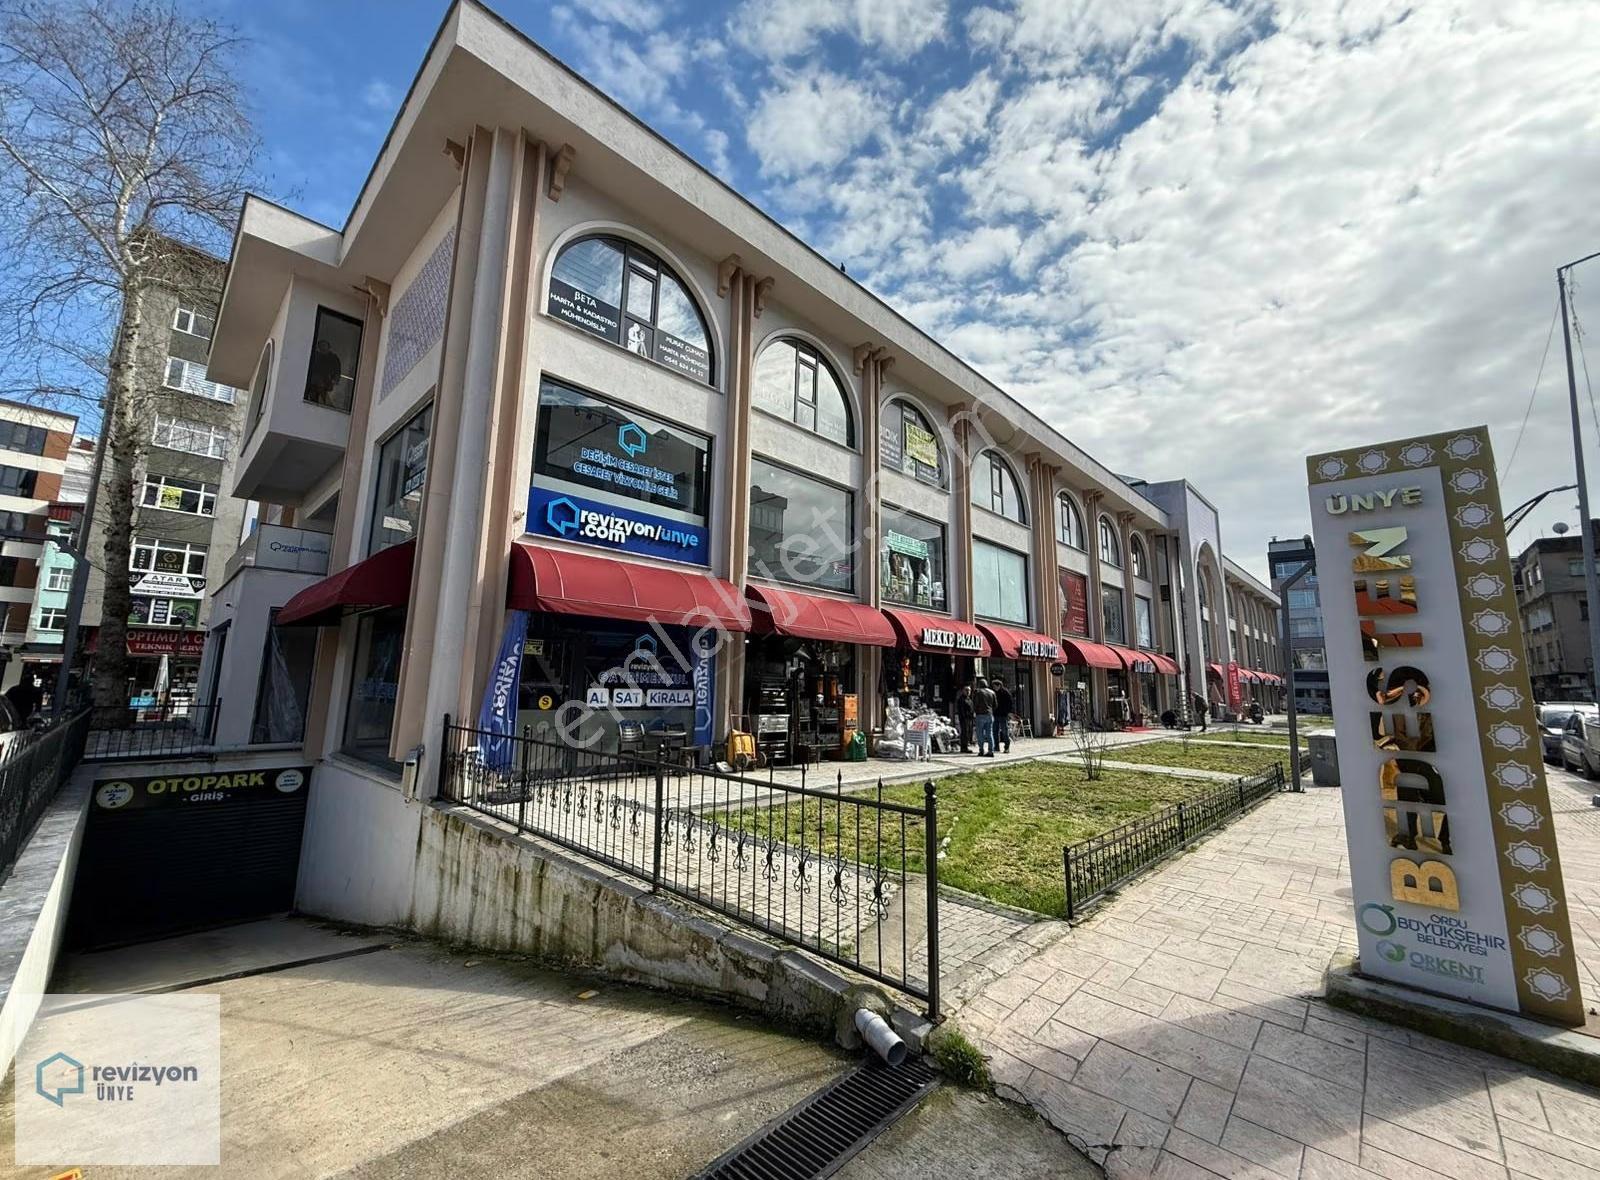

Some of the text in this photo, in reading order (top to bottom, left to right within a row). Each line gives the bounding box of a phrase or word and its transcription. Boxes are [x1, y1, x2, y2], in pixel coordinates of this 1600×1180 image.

[573, 461, 613, 481] CESARET
[1325, 485, 1424, 516] ÜNYE
[152, 575, 183, 583] ATAR
[923, 629, 984, 650] MEKKE PAZARI
[590, 691, 690, 704] AL SAT KİRALA
[1348, 526, 1460, 912] BEDESTEN
[147, 772, 266, 794] OTOPARK
[190, 791, 225, 802] GİRİŞ
[1430, 914, 1468, 929] ORDU
[1409, 952, 1484, 980] ORKENT
